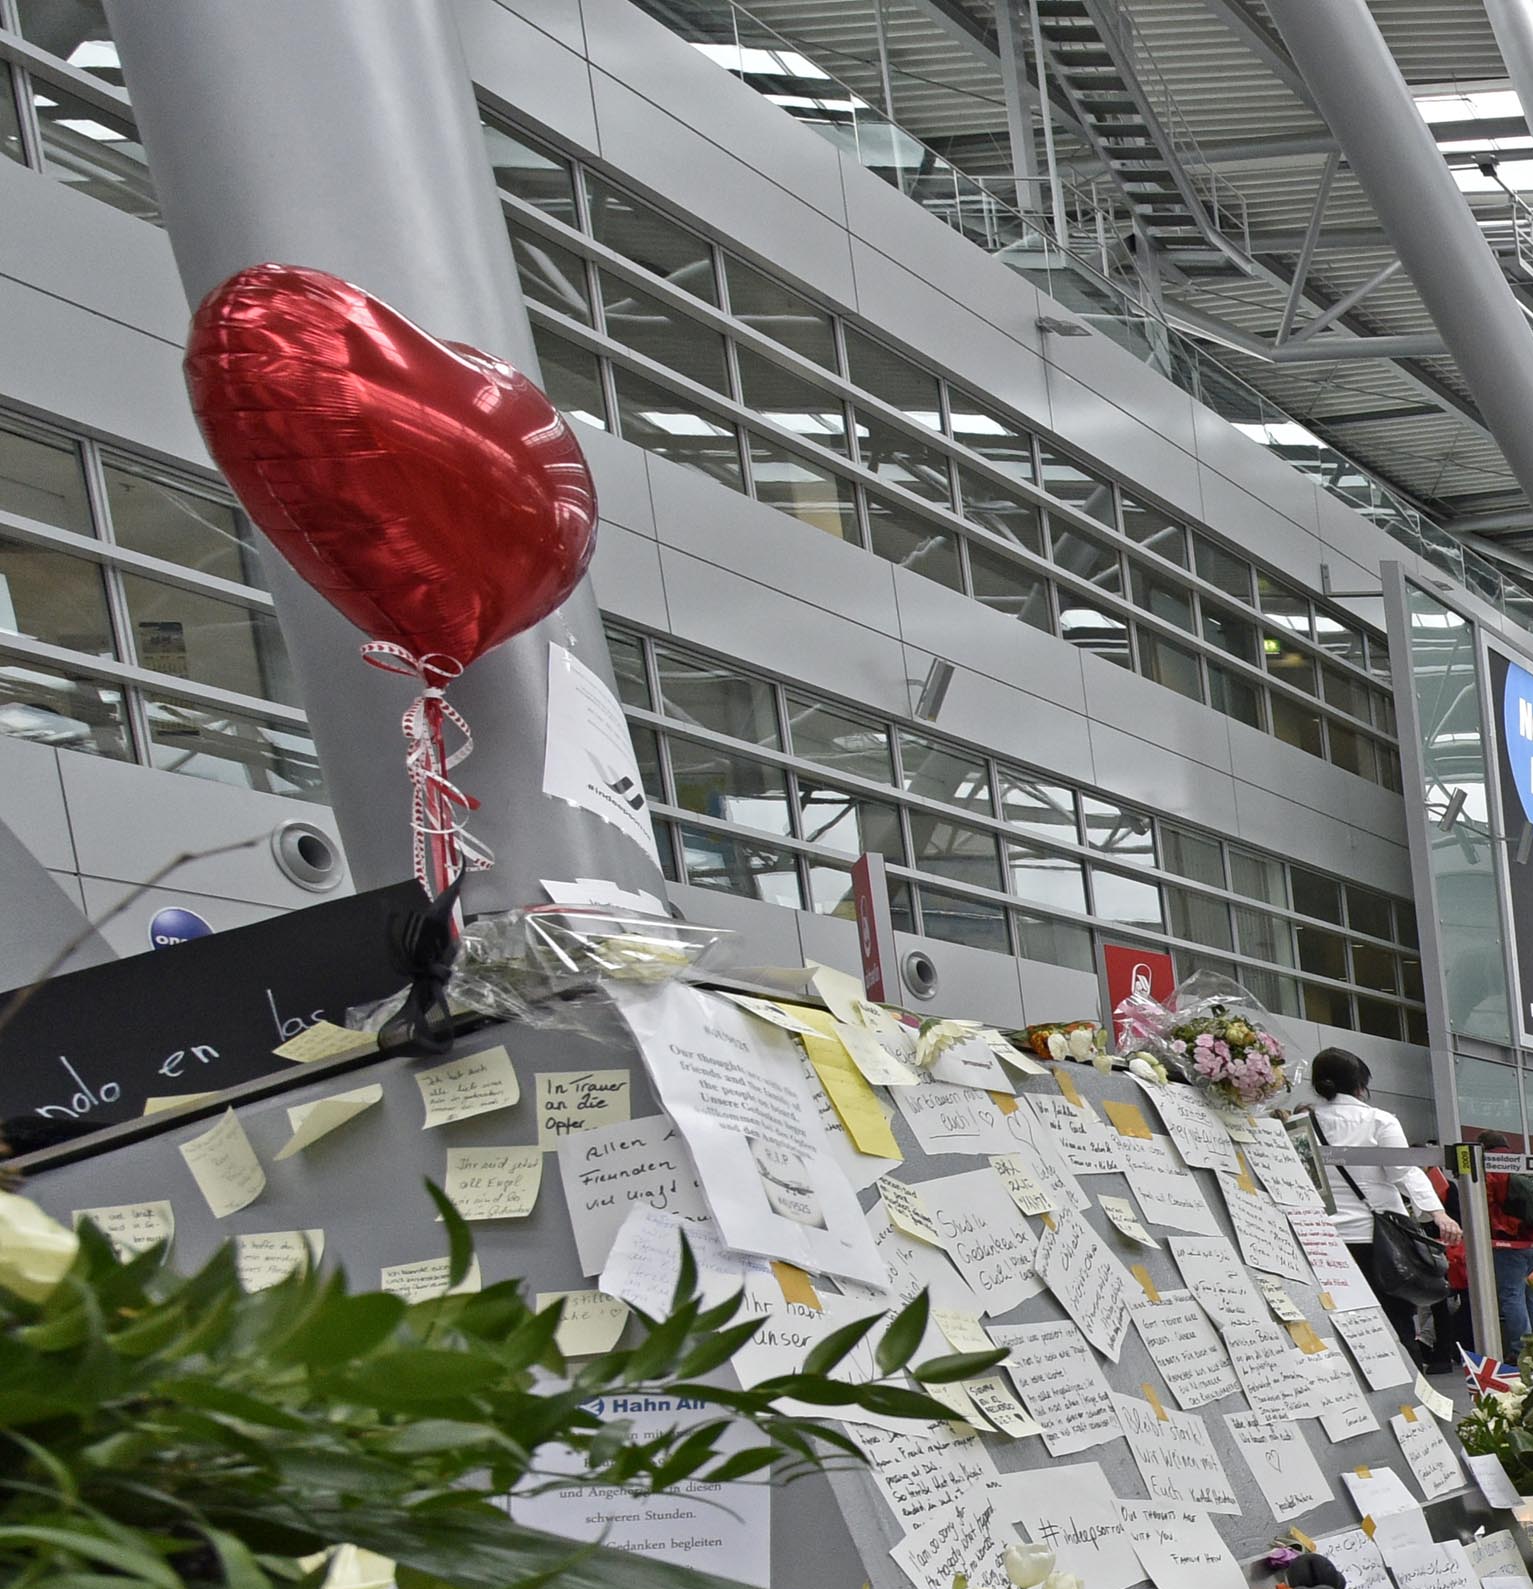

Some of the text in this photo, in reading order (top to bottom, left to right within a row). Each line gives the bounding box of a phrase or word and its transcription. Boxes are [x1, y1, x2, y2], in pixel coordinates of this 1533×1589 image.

[159, 1044, 220, 1077] en
[548, 1074, 627, 1094] In Trauer
[545, 1093, 609, 1111] an die
[545, 1117, 587, 1135] Opfer
[586, 1139, 646, 1161] Allen
[579, 1161, 677, 1185] Freunden
[613, 1399, 671, 1413] Hahn
[1120, 1405, 1164, 1438] Bleibt
[559, 1486, 583, 1499] und
[686, 1480, 722, 1494] diesen
[1151, 1474, 1182, 1501] Euch
[586, 1508, 696, 1524] schweren Stunden.
[671, 1534, 722, 1551] begleiten
